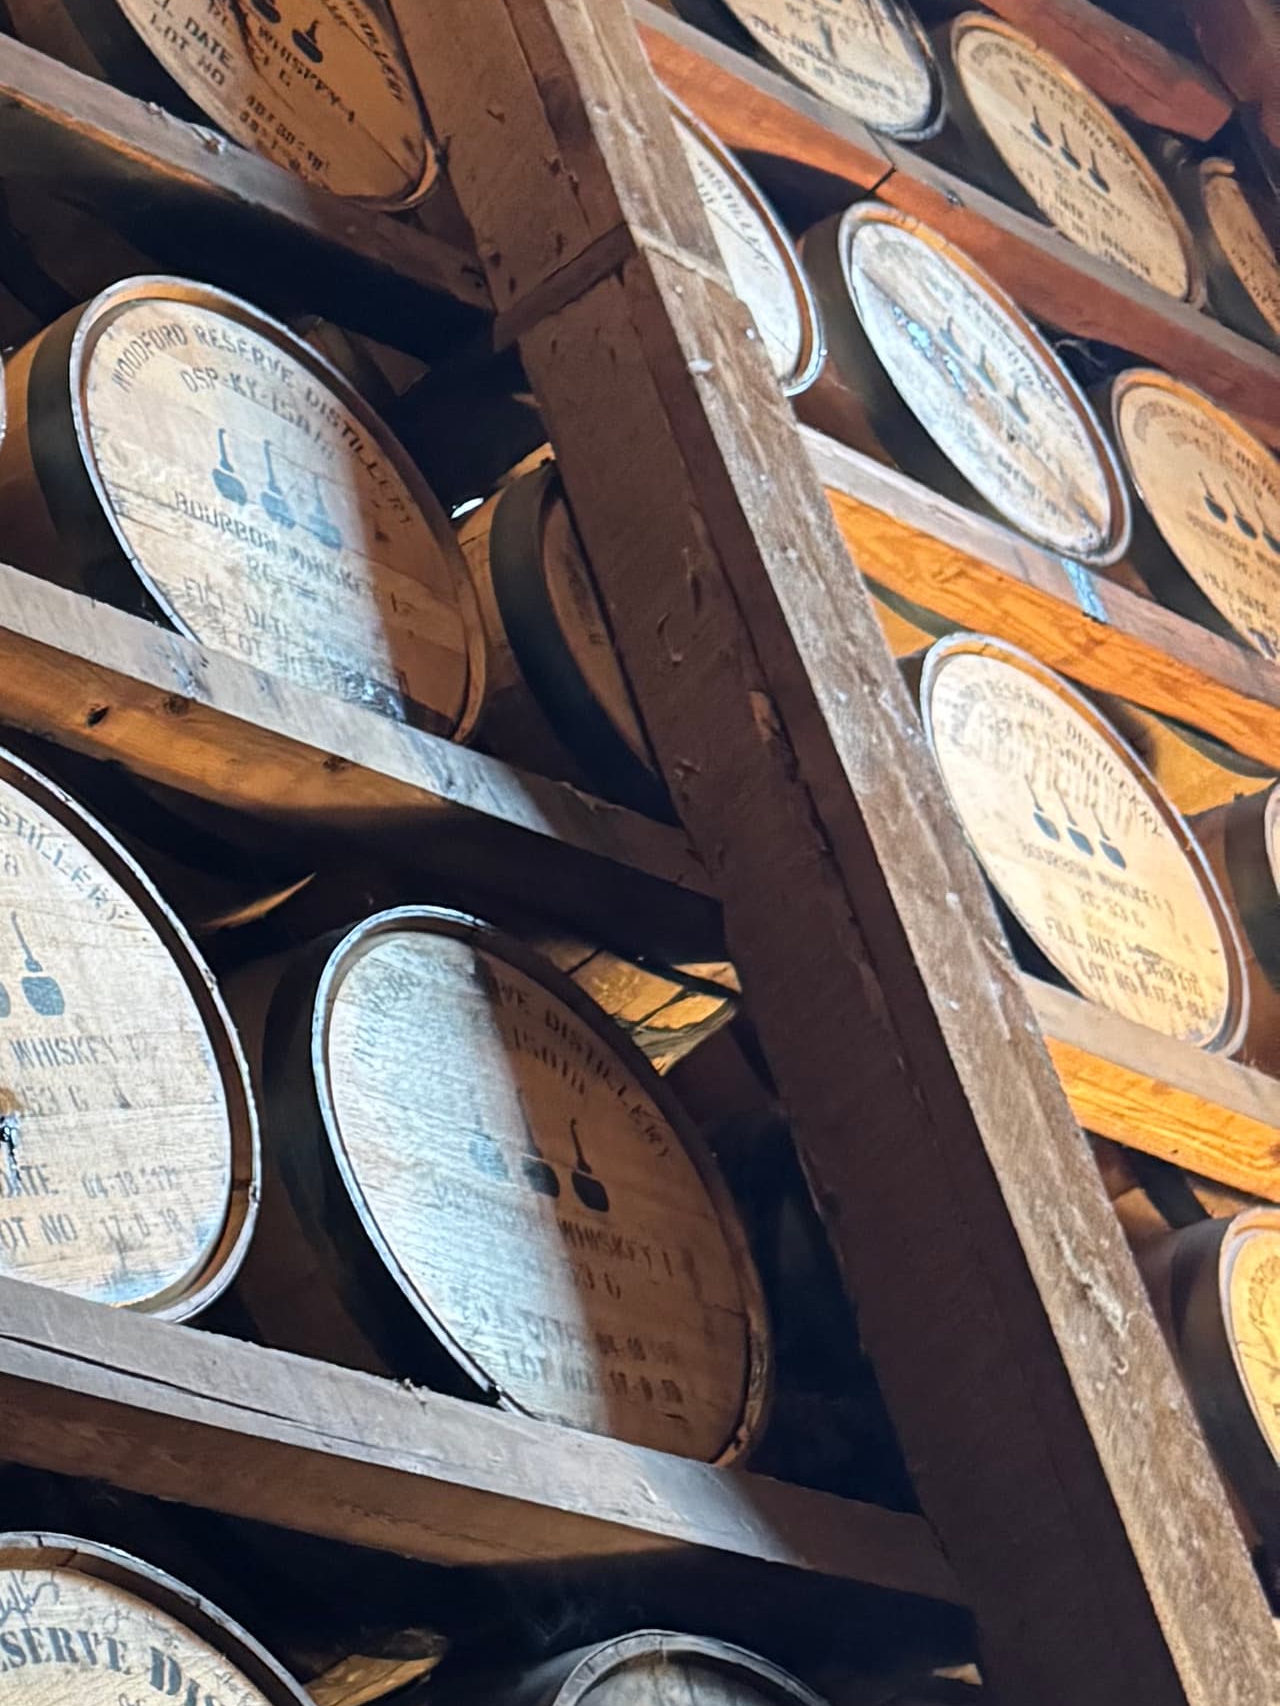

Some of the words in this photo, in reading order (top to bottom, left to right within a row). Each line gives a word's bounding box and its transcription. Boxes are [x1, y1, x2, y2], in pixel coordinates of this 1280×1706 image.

[193, 324, 295, 388] RESERVE
[9, 1035, 119, 1070] WHISKEY
[41, 1212, 79, 1246] NO
